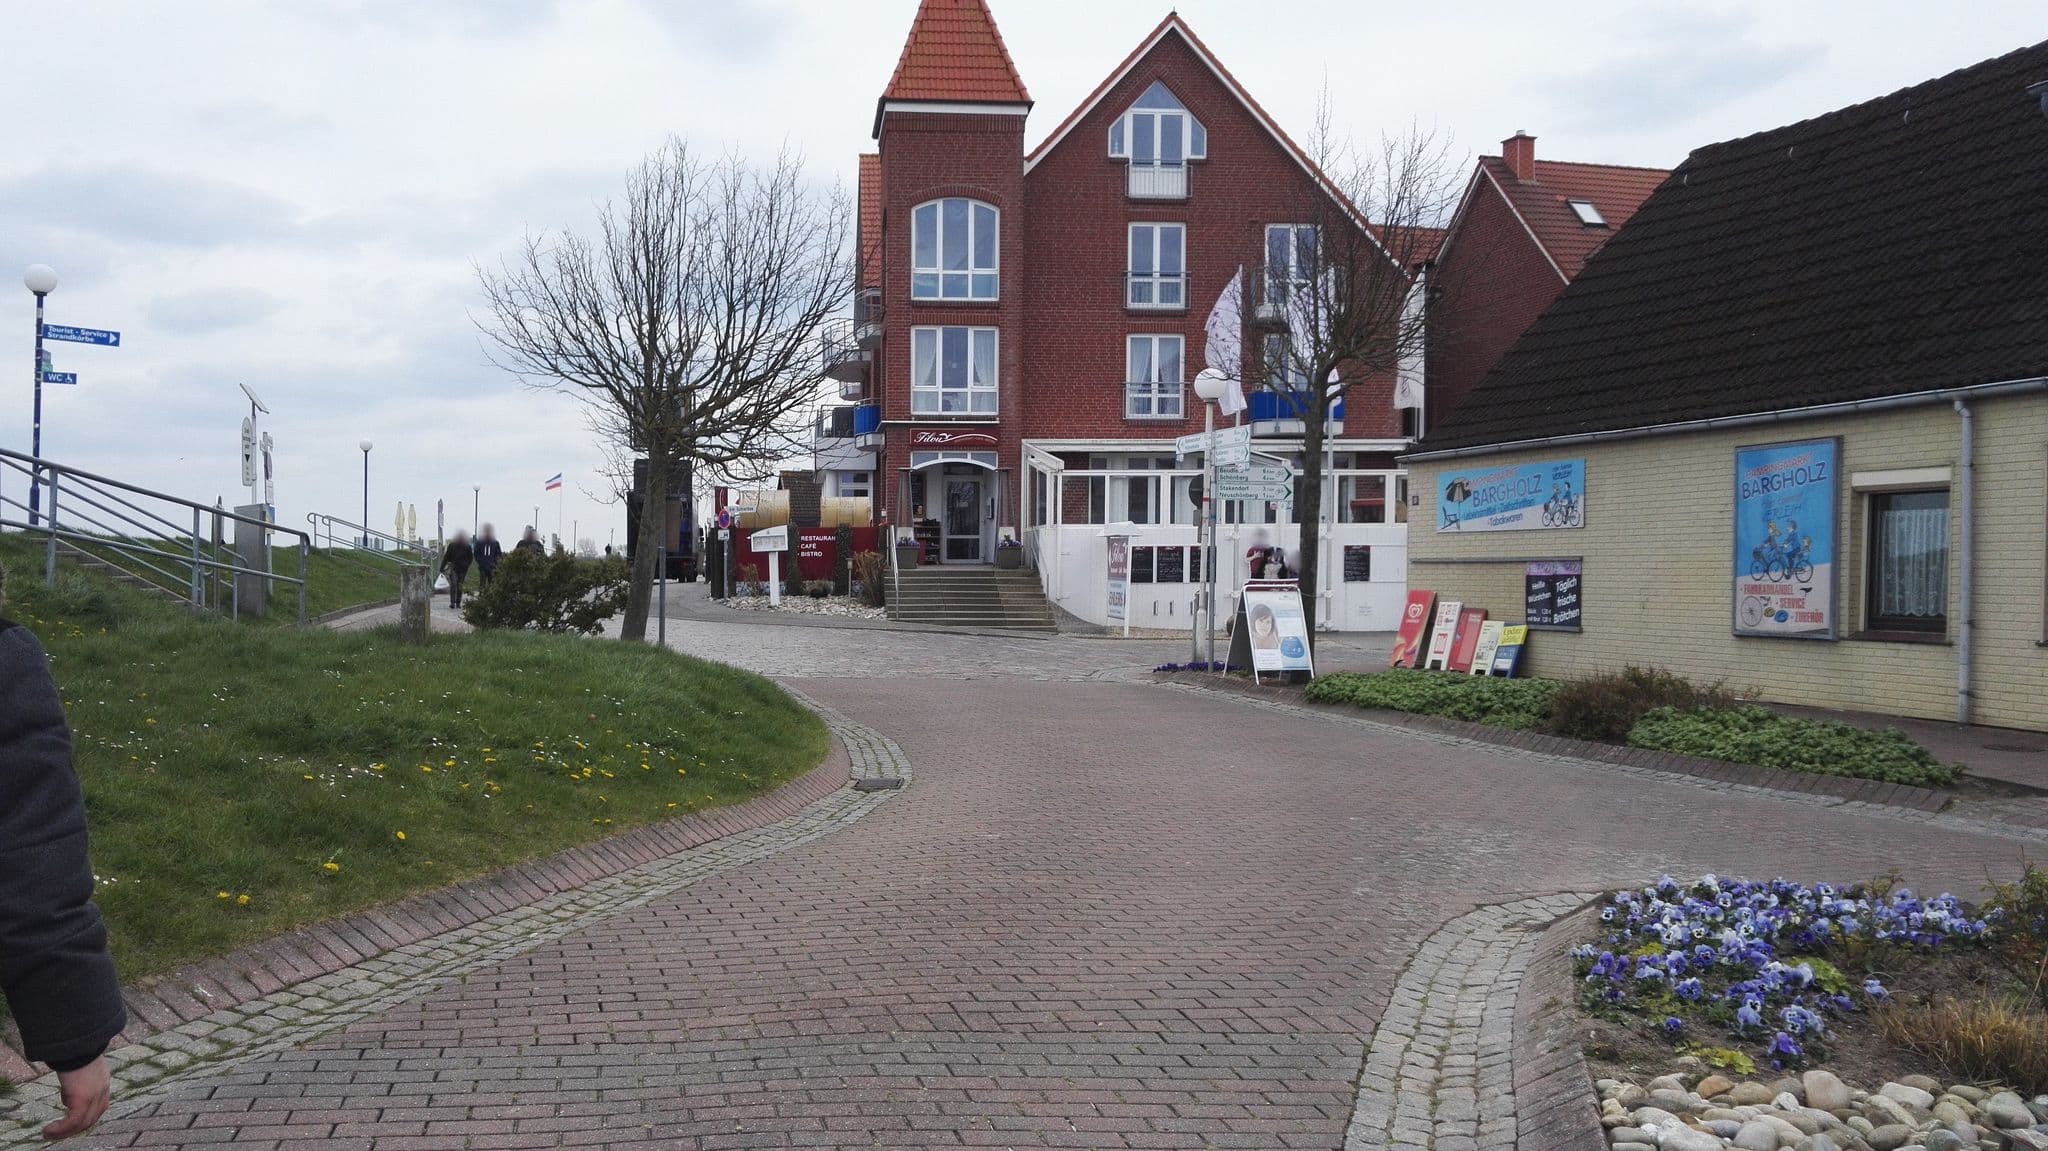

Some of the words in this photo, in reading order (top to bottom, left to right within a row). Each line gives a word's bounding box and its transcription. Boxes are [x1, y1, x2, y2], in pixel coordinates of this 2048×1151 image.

[48, 326, 74, 334] Tourist
[80, 329, 108, 338] Service
[48, 373, 63, 382] WC
[1742, 461, 1827, 500] BARGHOLZ
[1472, 474, 1543, 507] BARGHOLZ
[1556, 576, 1578, 593] Täglich
[1557, 593, 1577, 608] frische
[1780, 598, 1805, 609] SERVICE
[1553, 608, 1580, 624] Brötchen
[1795, 610, 1824, 623] ZUBEHÖR
